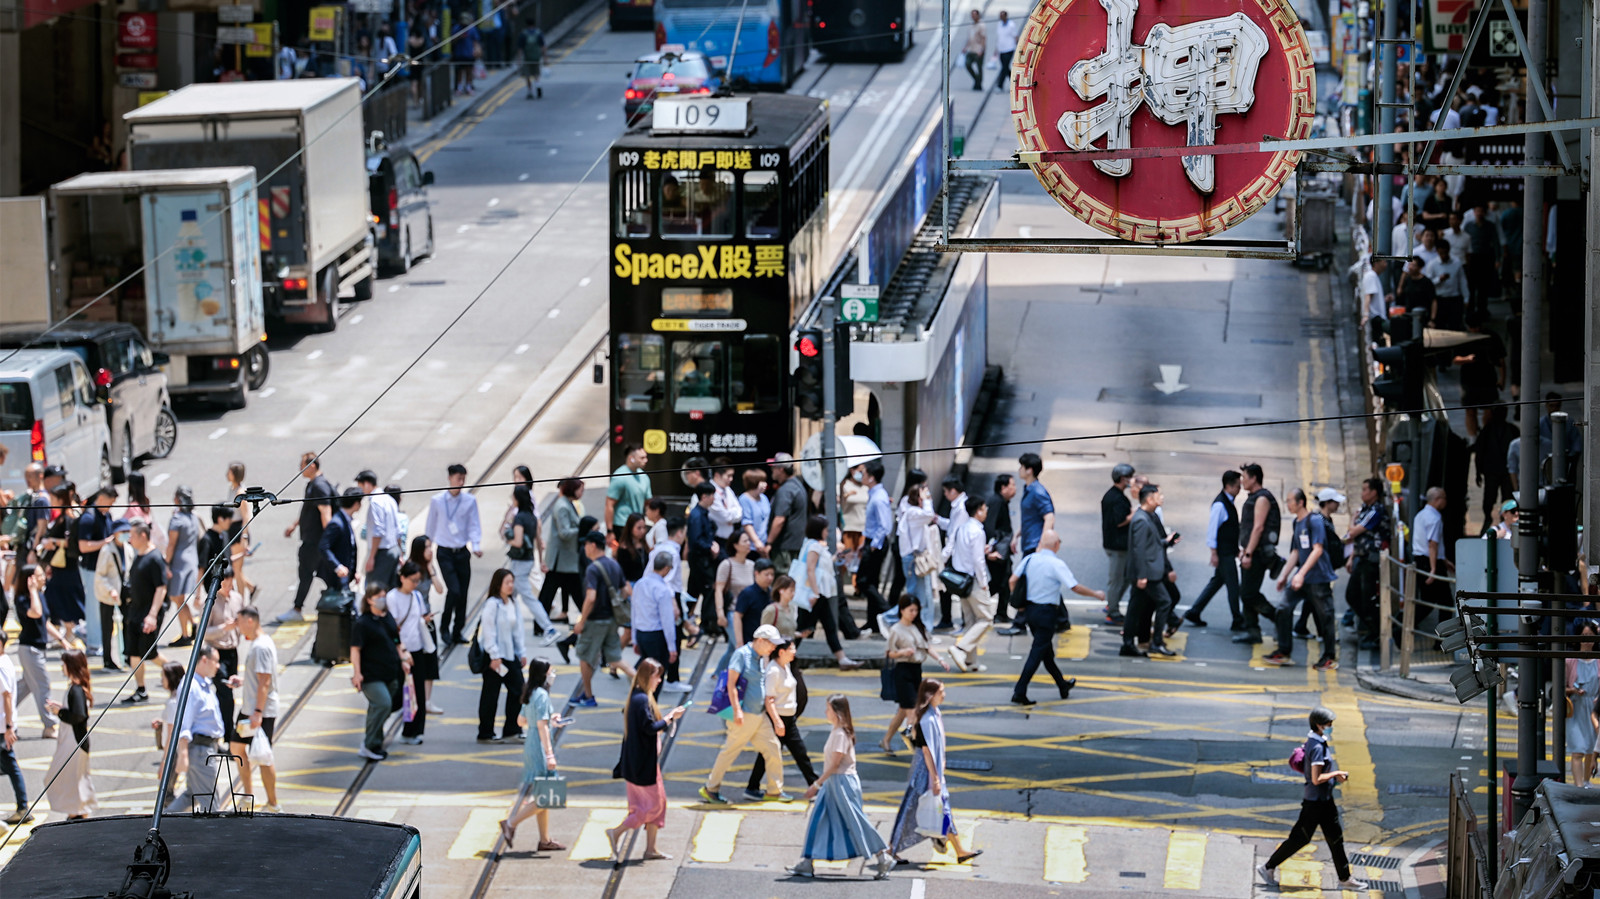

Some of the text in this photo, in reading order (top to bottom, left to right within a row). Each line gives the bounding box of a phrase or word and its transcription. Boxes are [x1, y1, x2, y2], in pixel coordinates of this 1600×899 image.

[1436, 24, 1468, 34] ELEVE
[675, 104, 720, 126] 109
[618, 152, 640, 167] 109
[643, 150, 752, 170] 老虎開戶即送
[760, 153, 781, 168] 109
[614, 243, 785, 286] SpaceX股票
[669, 432, 697, 442] TIGER
[669, 443, 700, 453] TRADE
